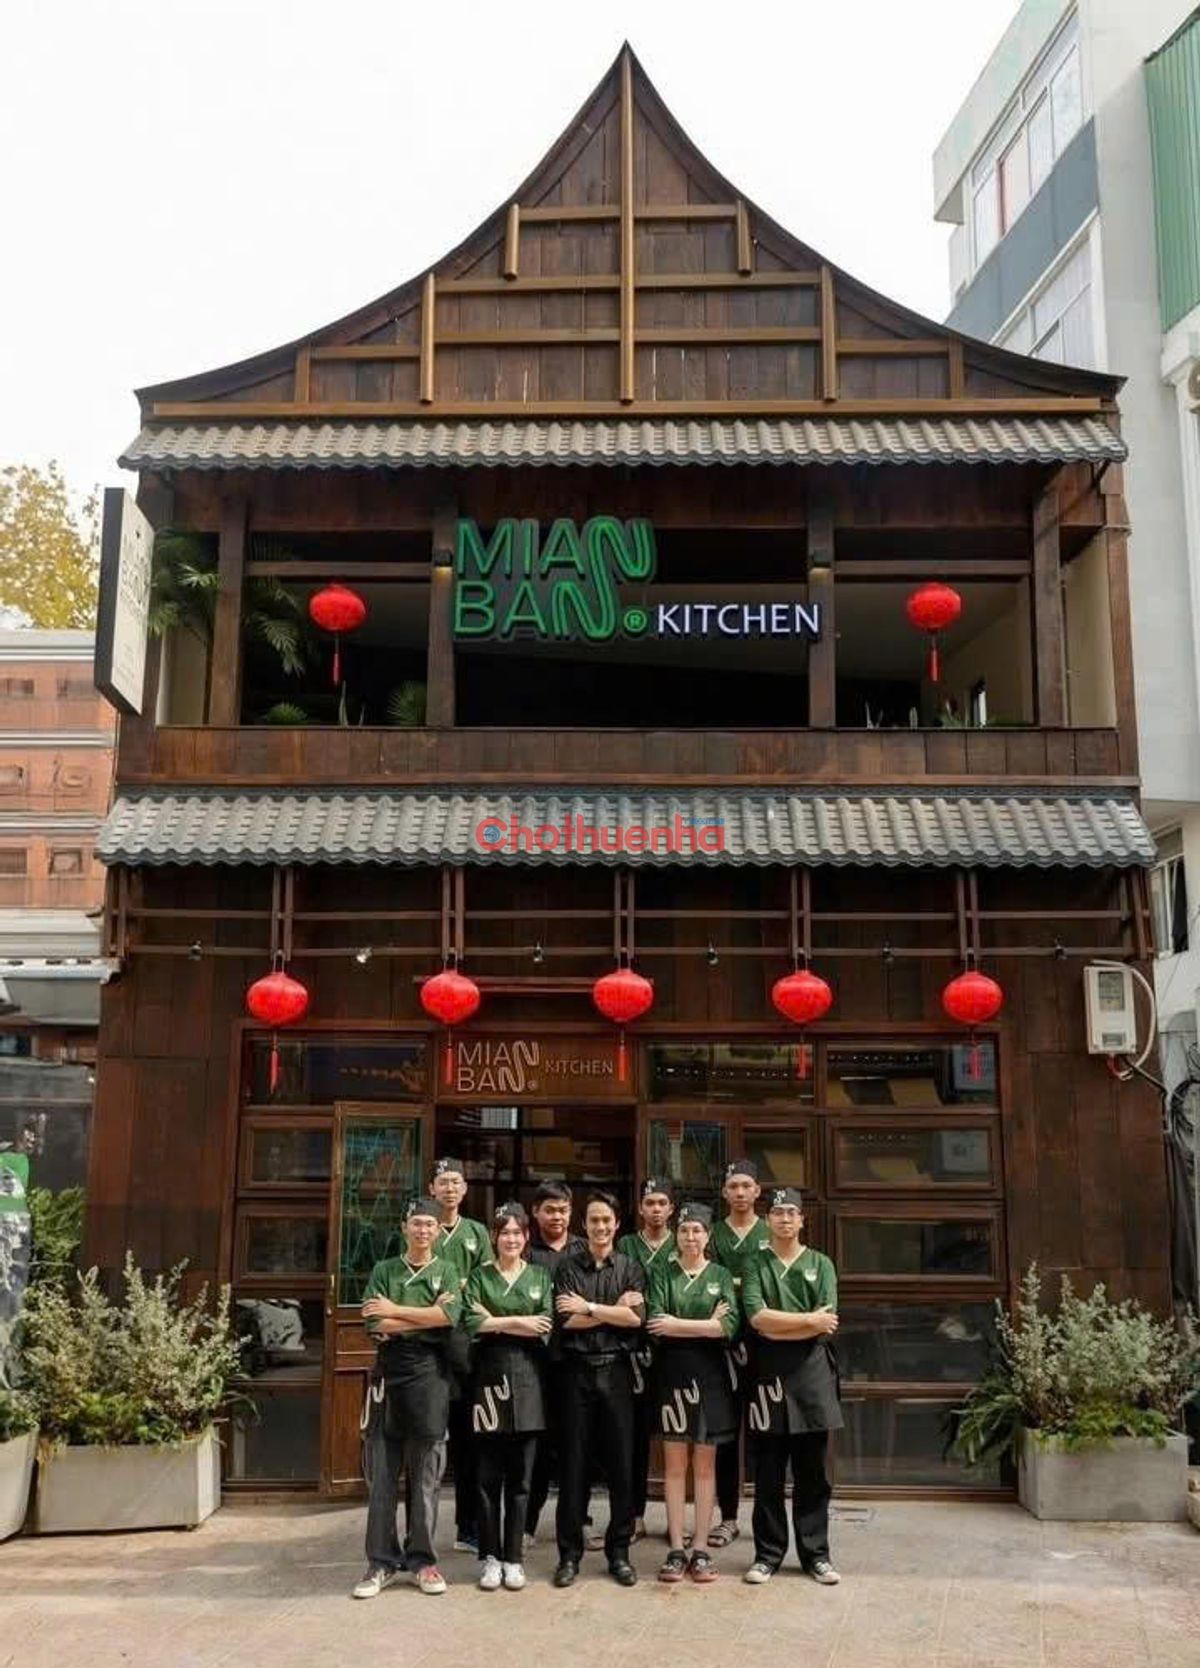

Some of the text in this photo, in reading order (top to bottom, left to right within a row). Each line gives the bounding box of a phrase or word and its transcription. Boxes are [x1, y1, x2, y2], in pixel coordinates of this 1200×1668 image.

[456, 516, 655, 579] MIAN
[657, 604, 820, 635] KITCHEN
[457, 1040, 540, 1066] MIAN
[545, 1059, 614, 1076] KITCHEN
